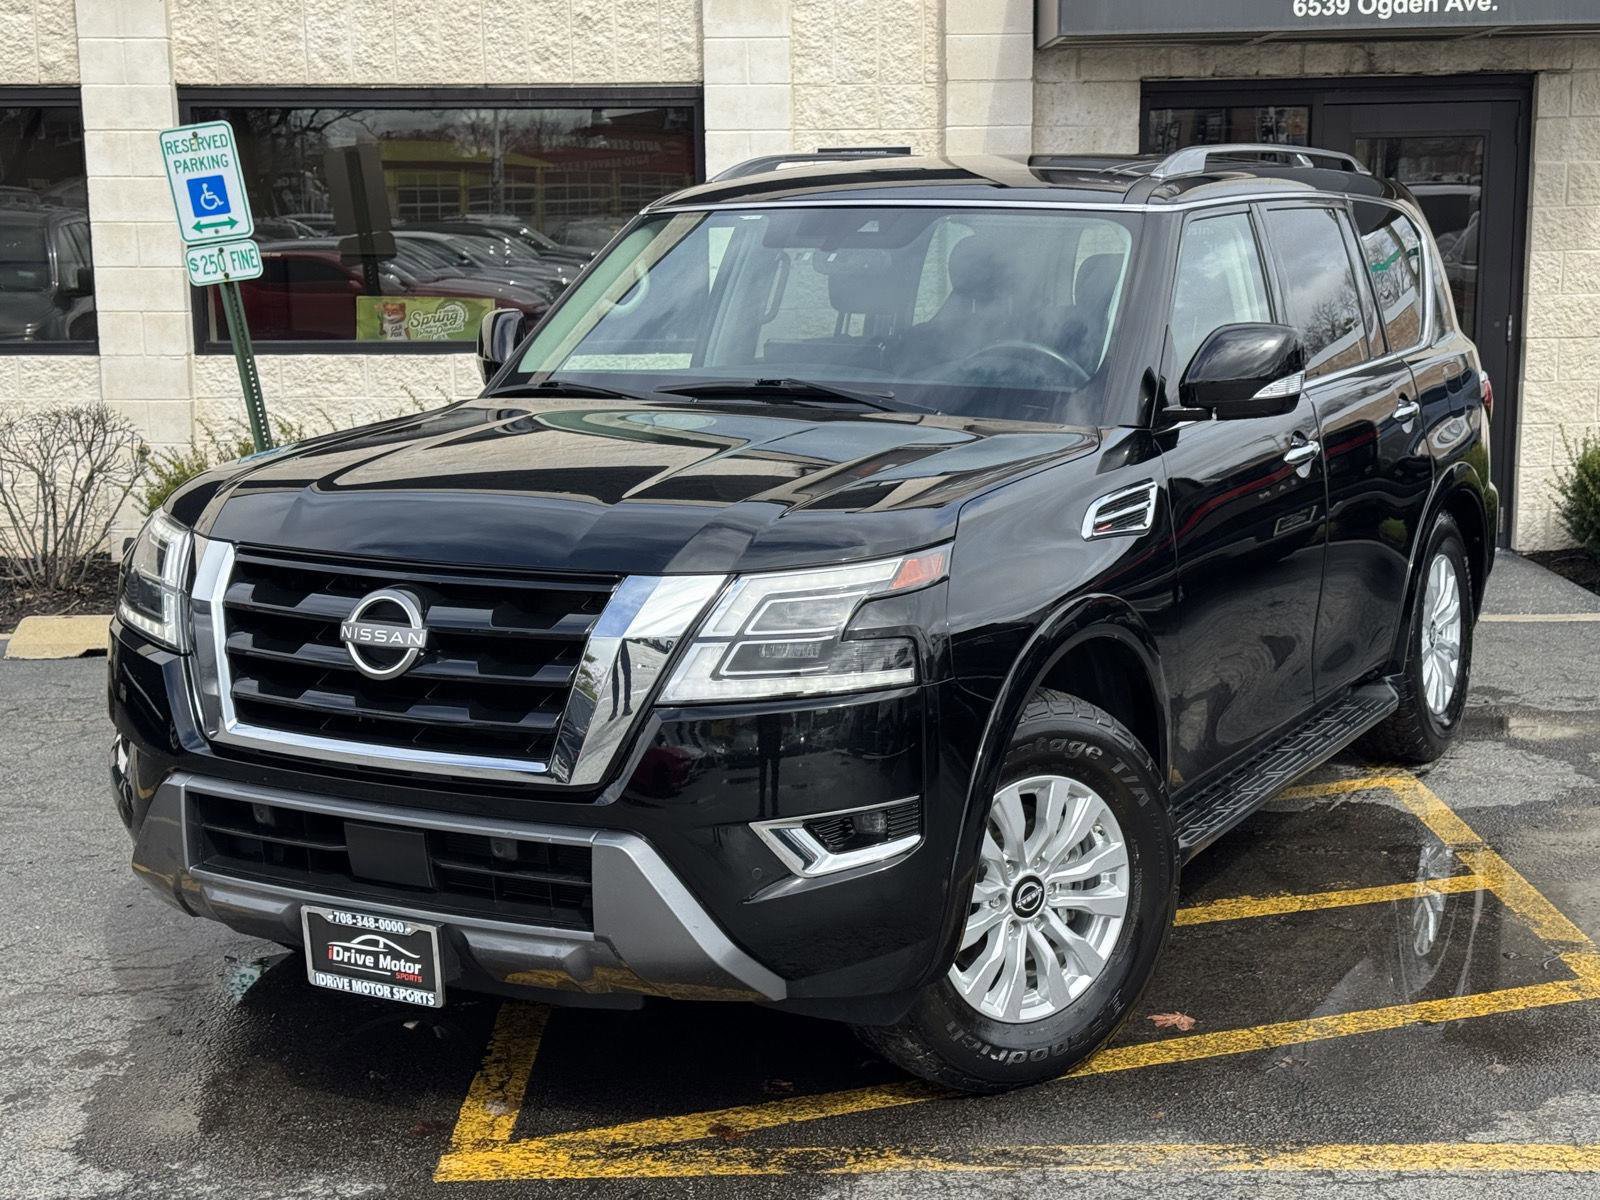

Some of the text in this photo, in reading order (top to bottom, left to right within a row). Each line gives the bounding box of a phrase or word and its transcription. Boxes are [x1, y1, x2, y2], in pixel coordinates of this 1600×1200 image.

[1292, 0, 1498, 19] 6539 Ogden Ave.
[165, 134, 229, 156] RESERVED
[173, 154, 229, 175] PARKING
[189, 248, 259, 276] $250 FINE
[411, 312, 459, 328] Spring
[341, 626, 423, 645] NISSAN
[334, 912, 405, 932] 708-348-0000
[327, 944, 422, 975] iDrive Motor
[395, 972, 423, 983] SPORTS
[351, 979, 391, 999] MOTOR
[393, 989, 435, 1006] SPORTS
